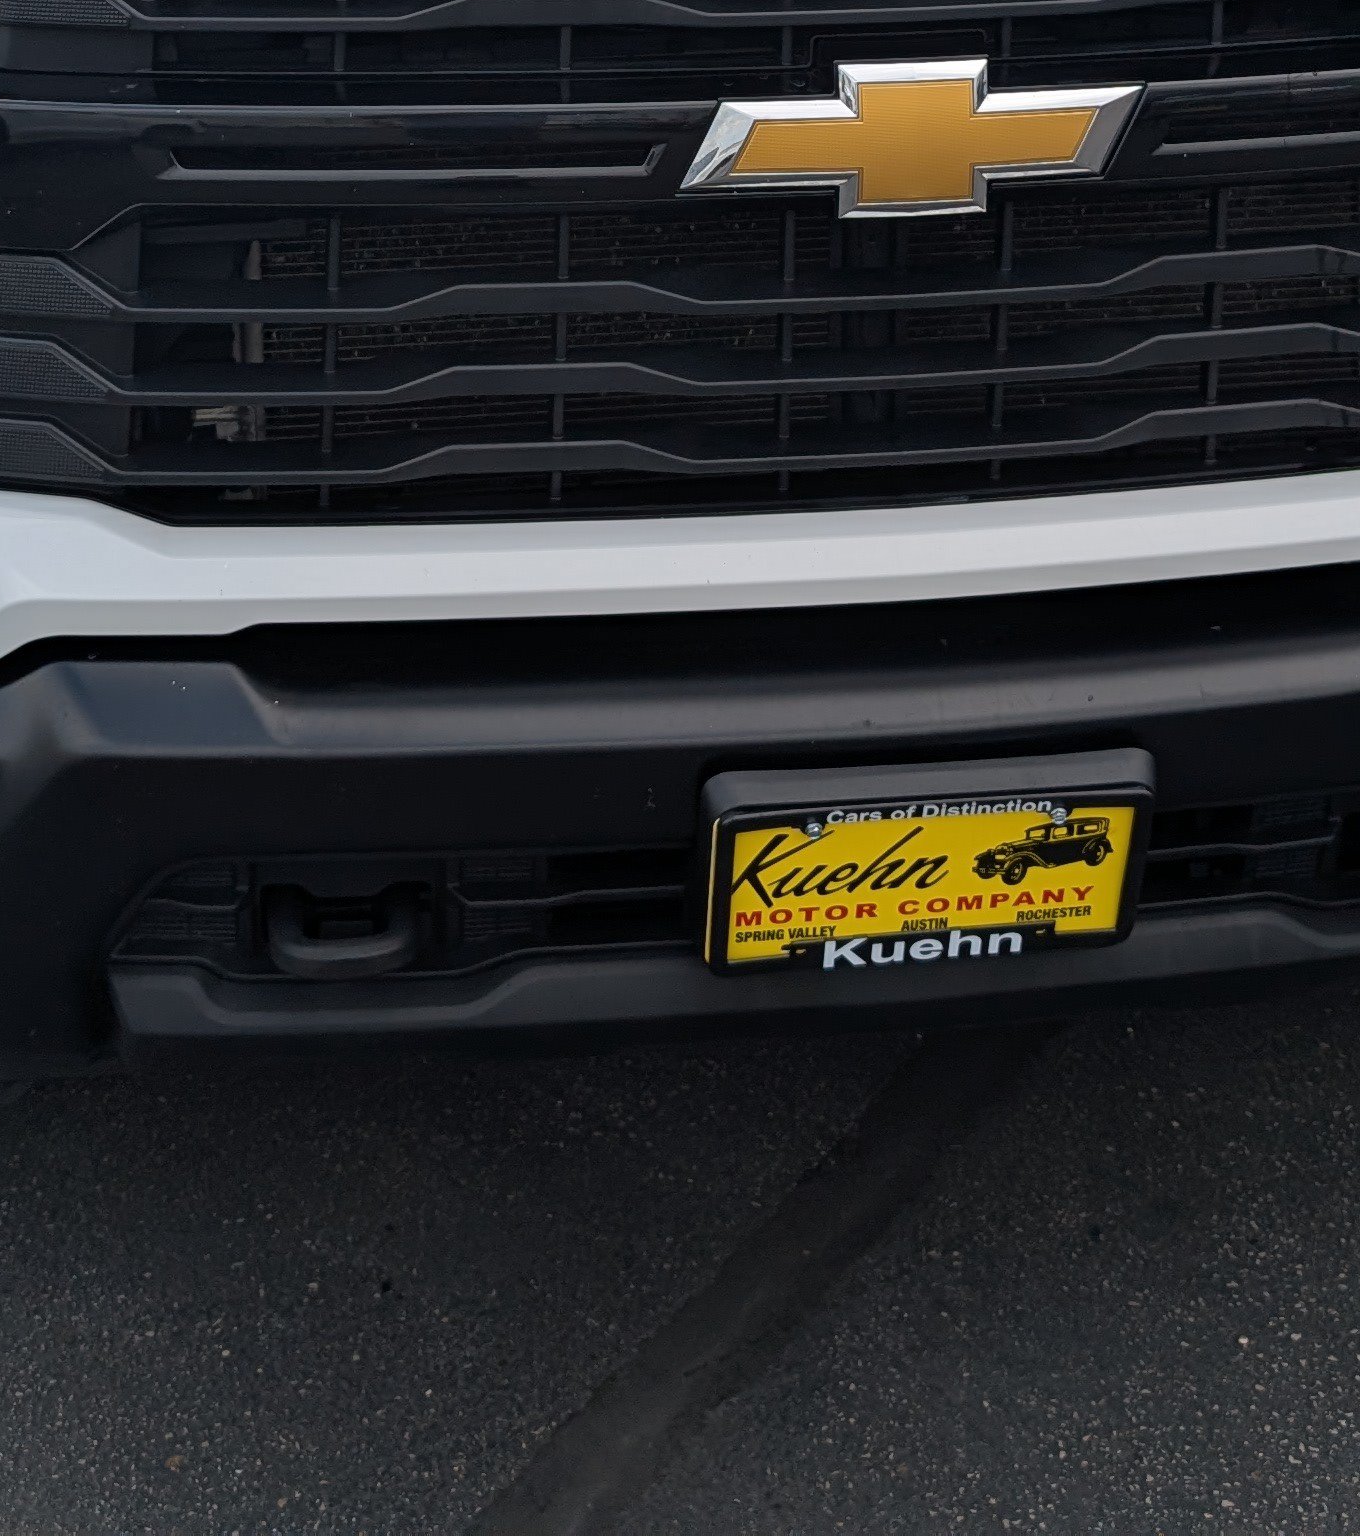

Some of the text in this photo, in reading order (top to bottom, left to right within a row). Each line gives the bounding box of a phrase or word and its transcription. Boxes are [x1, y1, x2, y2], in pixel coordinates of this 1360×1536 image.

[826, 799, 1052, 825] Cars of Distinction
[730, 825, 950, 909] Kuehn
[735, 885, 1095, 927] MOTOR COMPANY
[1016, 905, 1092, 923] ROCHESTER
[735, 925, 837, 943] SPRING VALLEY
[901, 917, 949, 932] AUSTIN
[822, 928, 1024, 970] Kuehn
